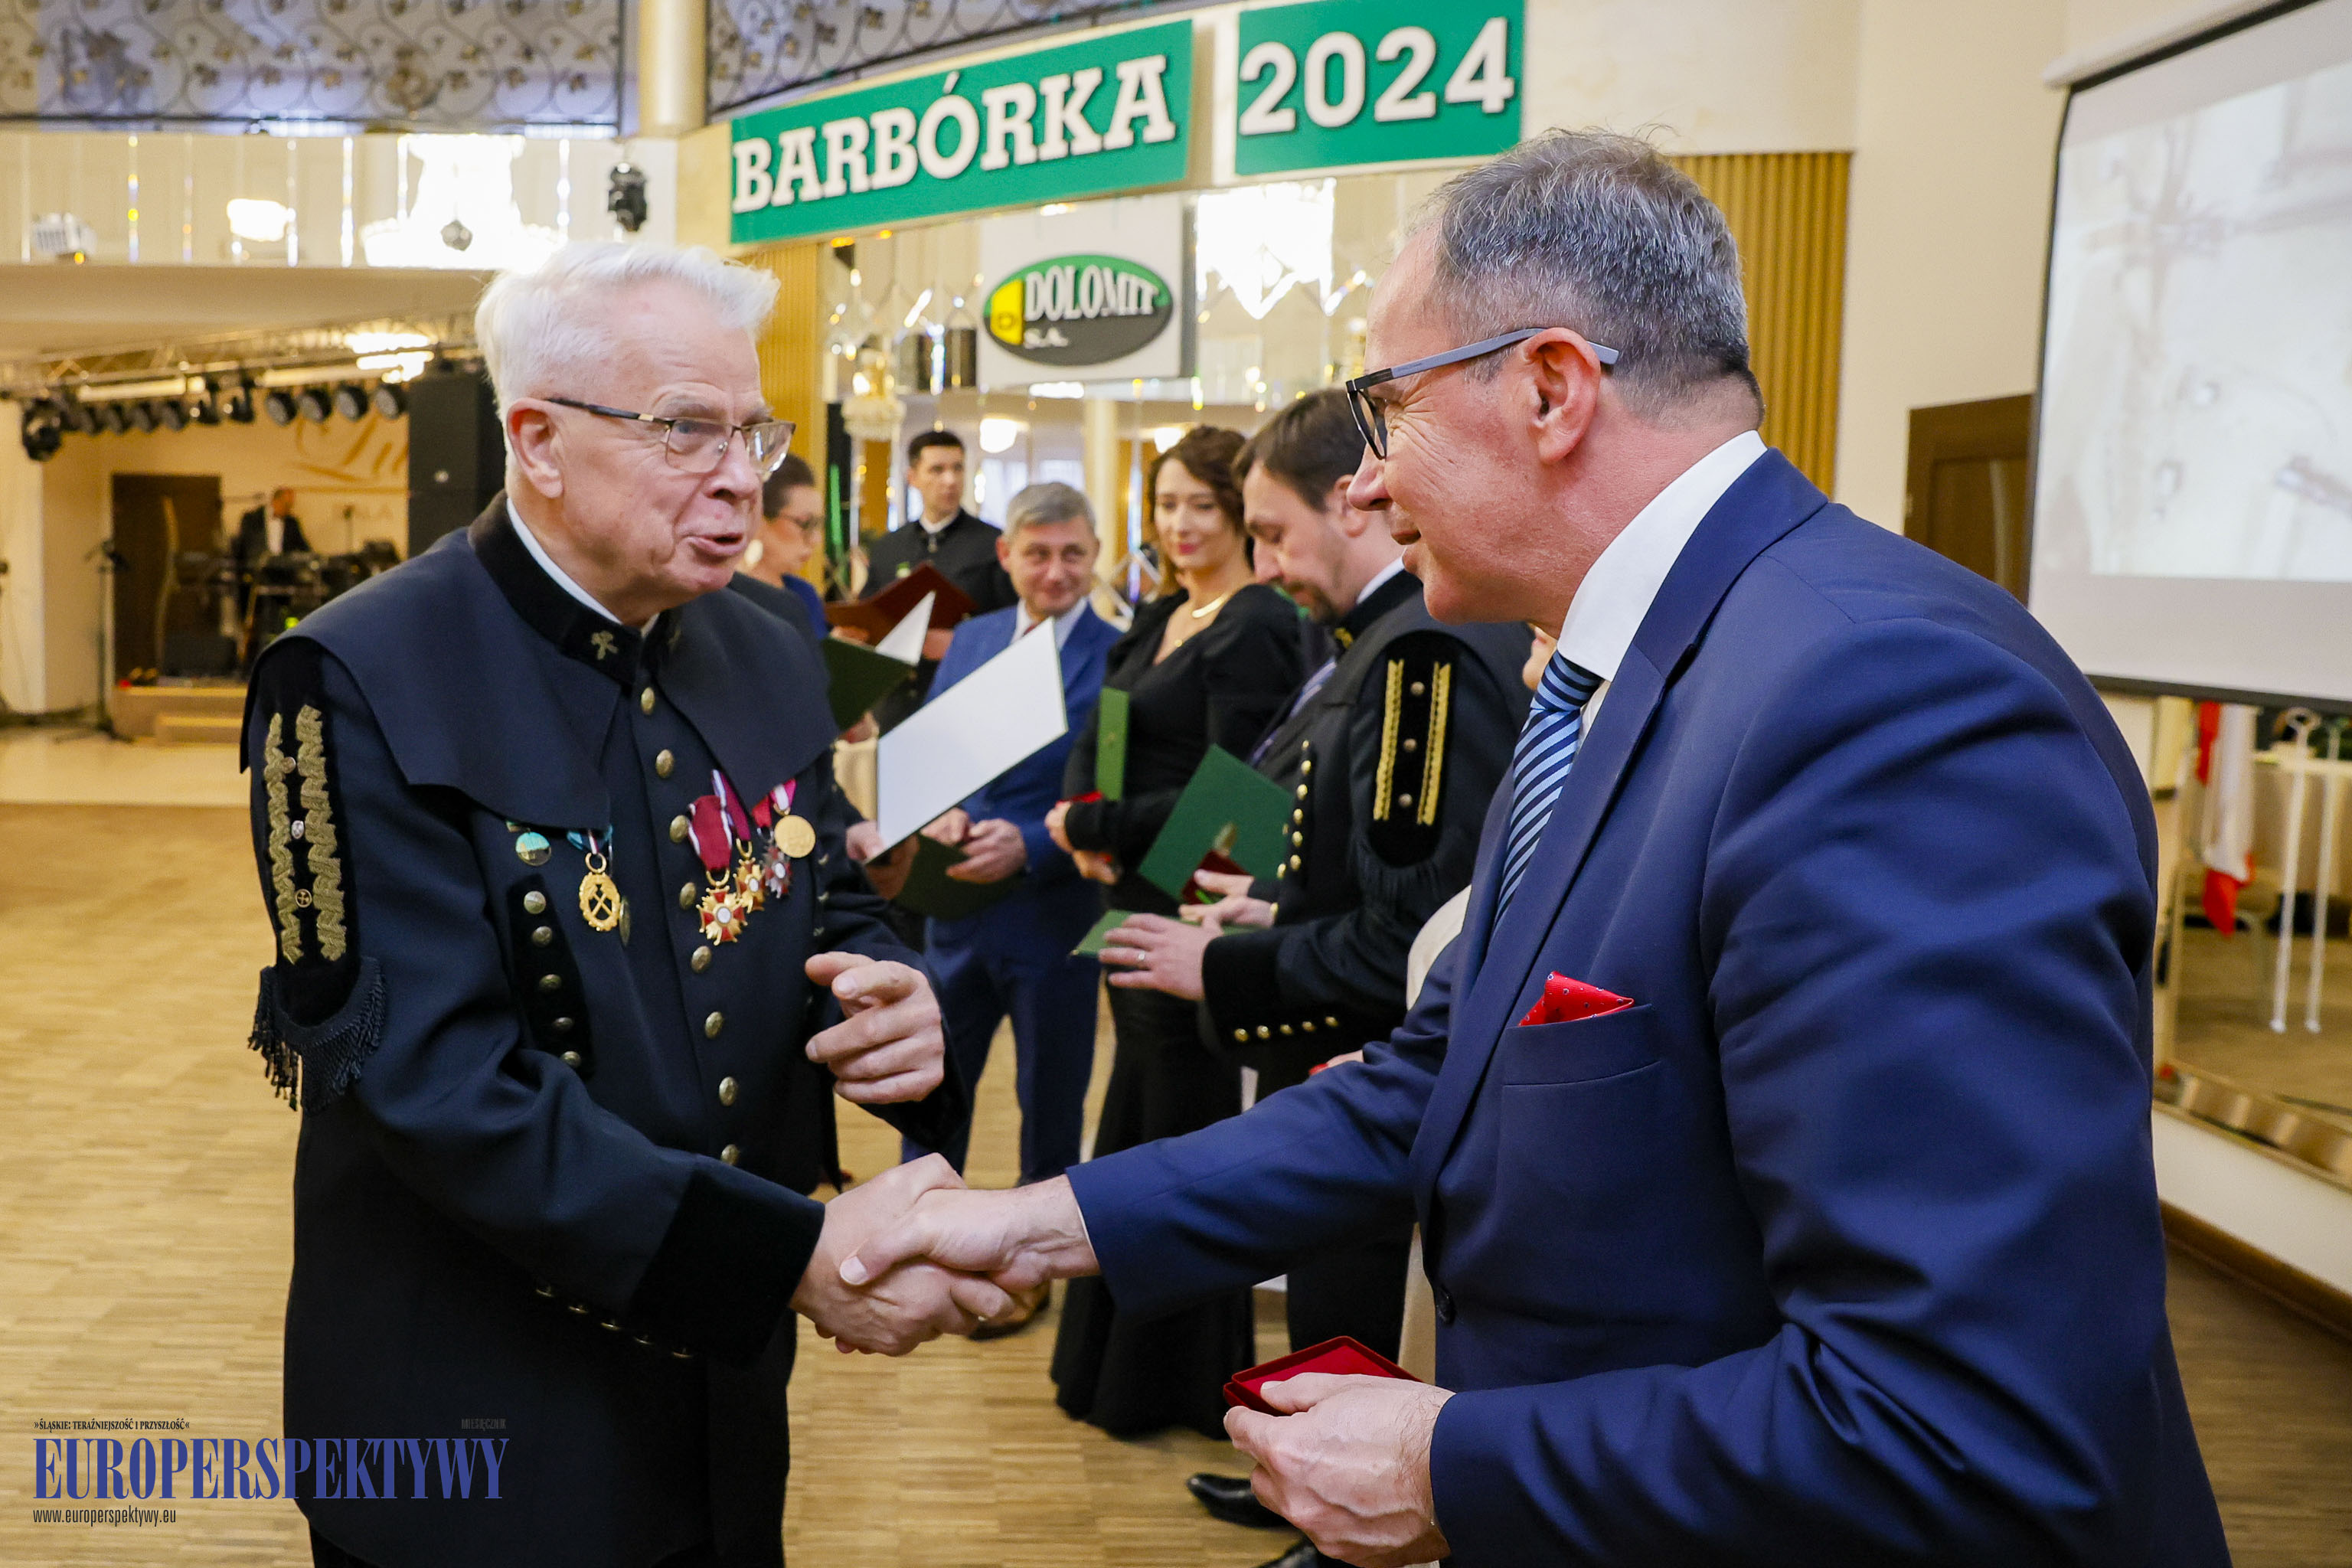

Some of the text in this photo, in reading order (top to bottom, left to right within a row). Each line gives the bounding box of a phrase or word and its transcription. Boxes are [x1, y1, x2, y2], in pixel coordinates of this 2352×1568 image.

[732, 17, 1514, 213] BARBÓRKA 2024
[1024, 264, 1159, 322] DOLOMIT
